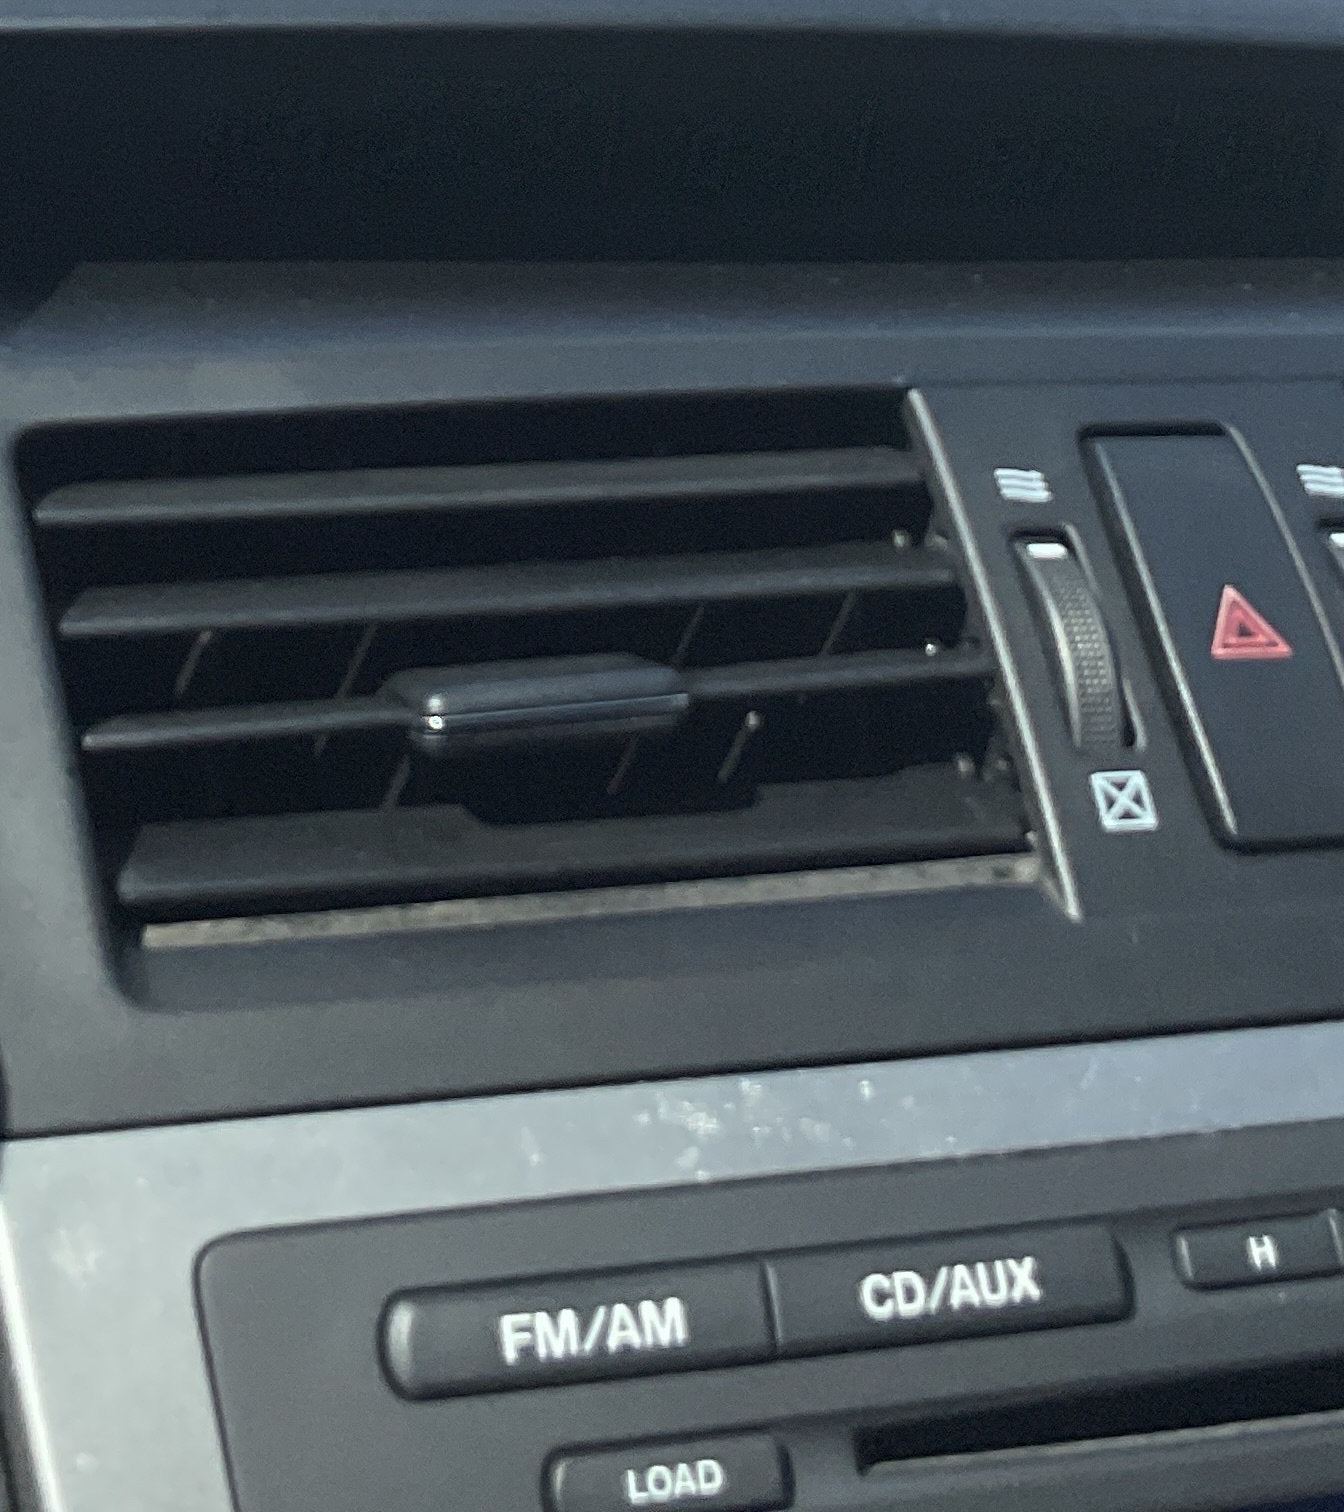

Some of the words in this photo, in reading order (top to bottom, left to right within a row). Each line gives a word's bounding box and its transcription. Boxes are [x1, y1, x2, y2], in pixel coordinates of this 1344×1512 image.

[1246, 1234, 1278, 1270] H
[859, 1255, 1043, 1321] CD/AUX
[497, 1296, 689, 1366] FM/AM
[624, 1459, 726, 1505] LOAD
